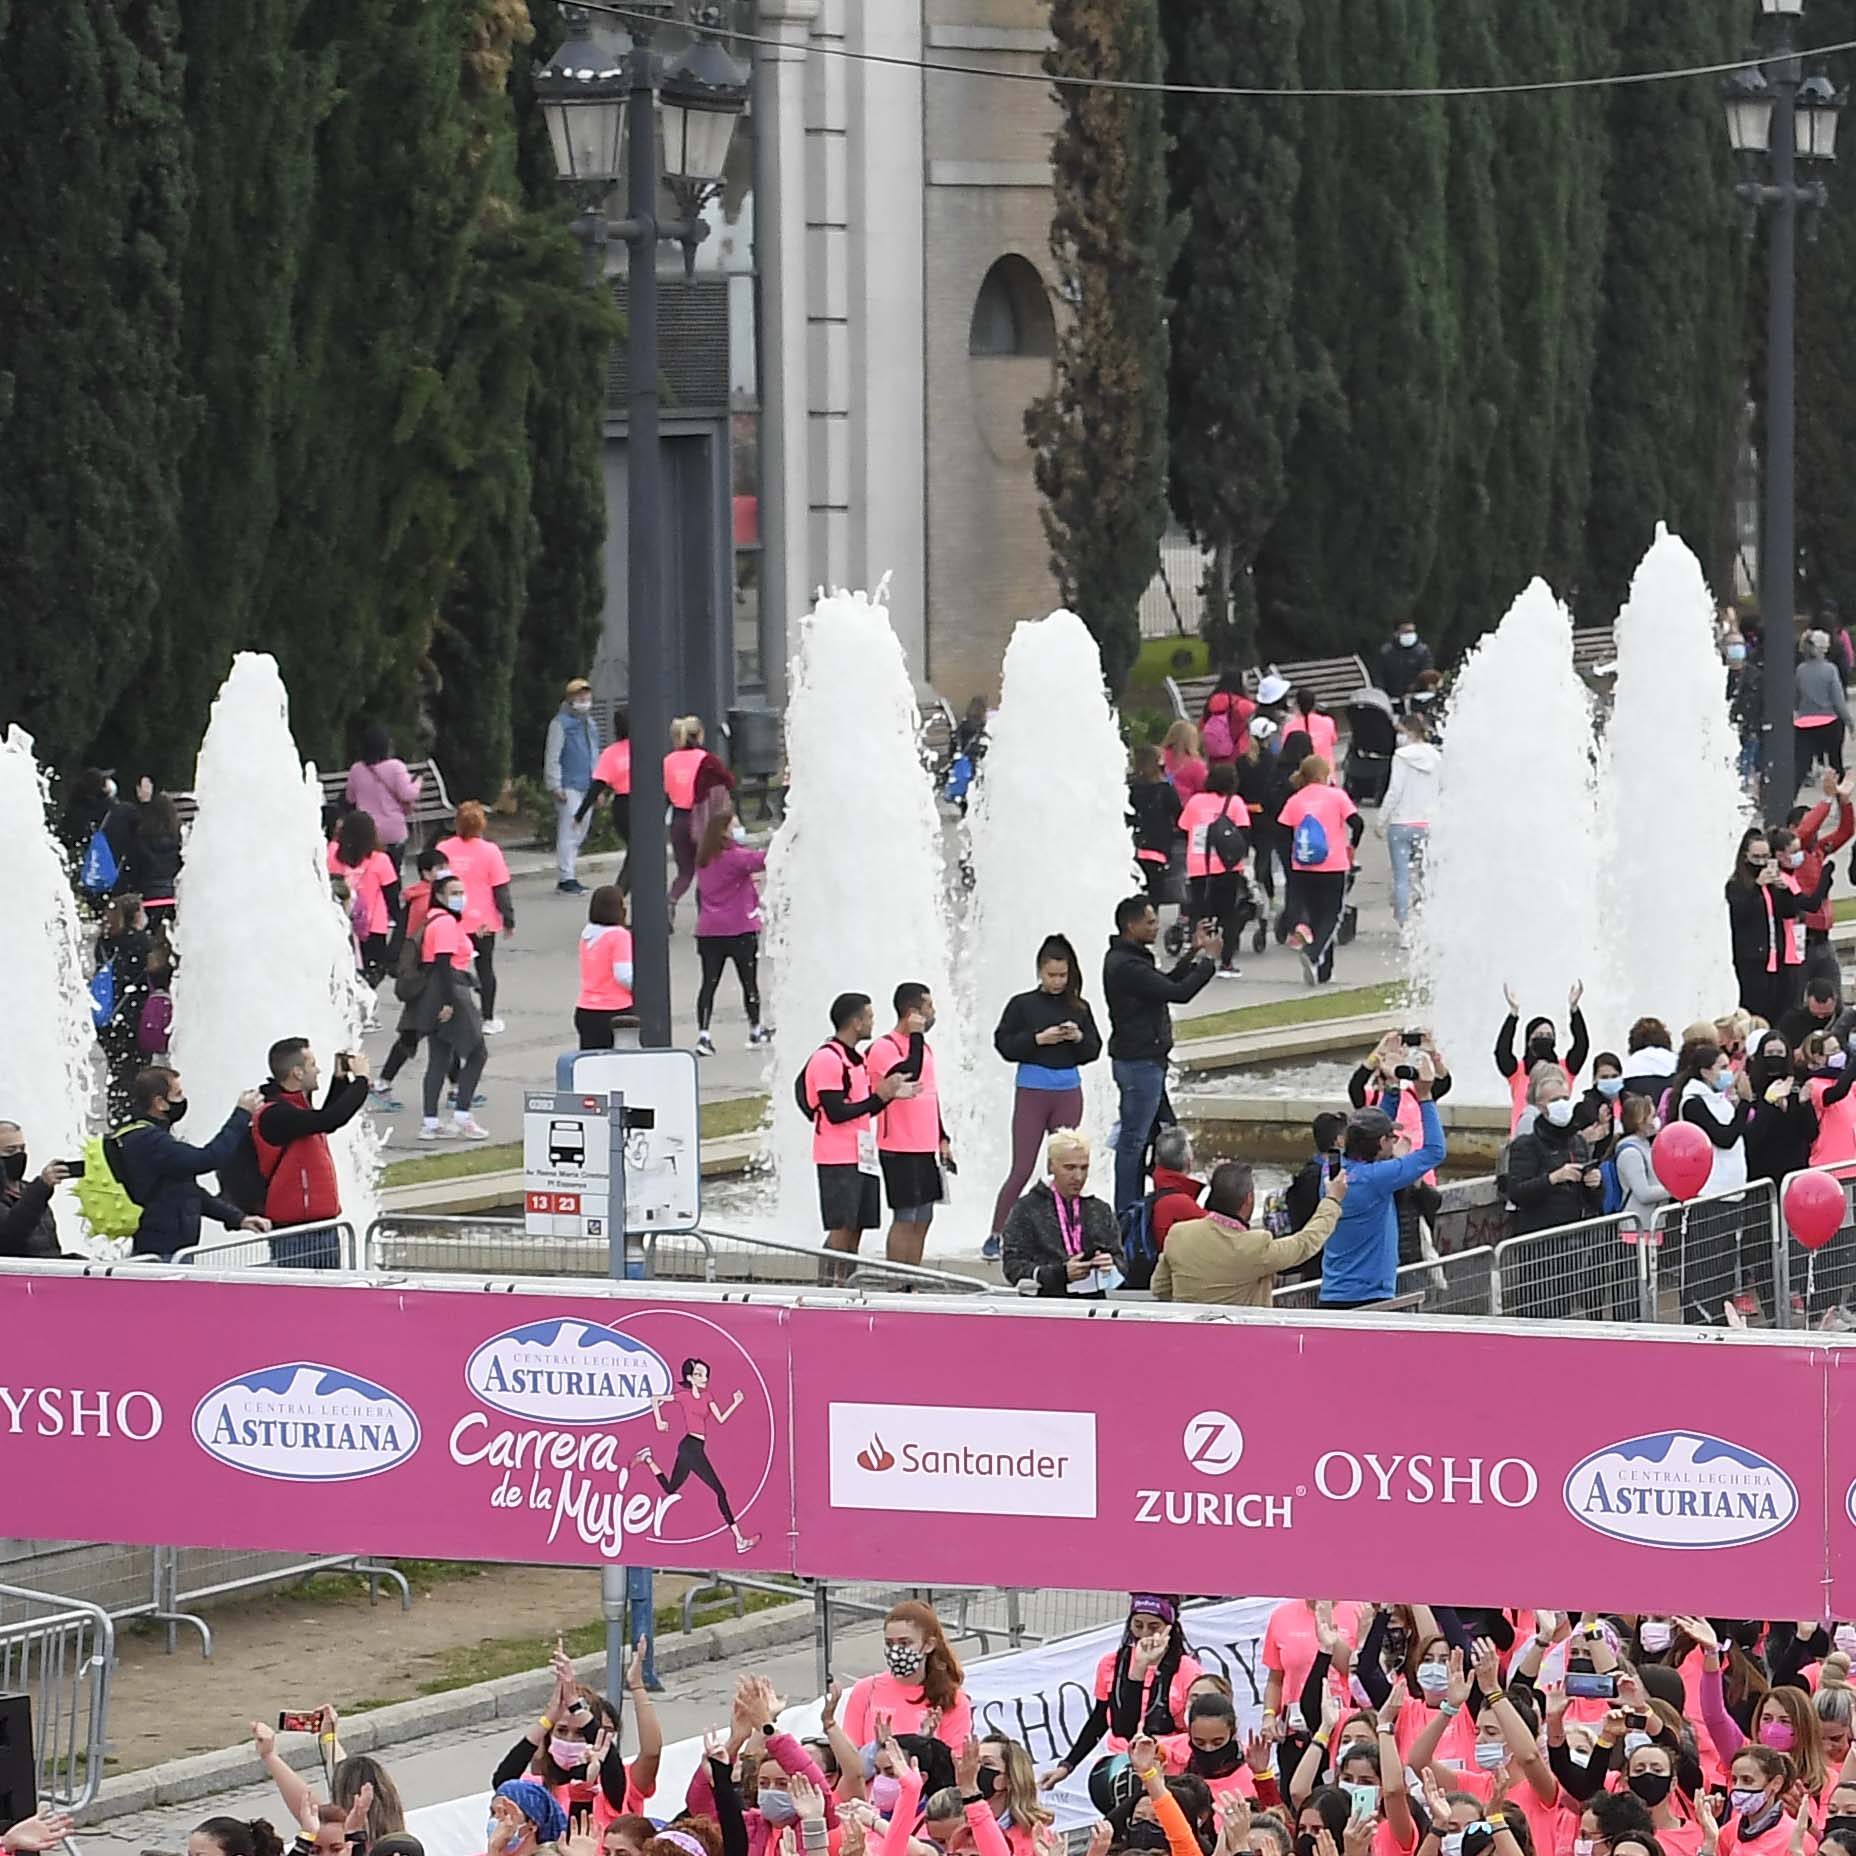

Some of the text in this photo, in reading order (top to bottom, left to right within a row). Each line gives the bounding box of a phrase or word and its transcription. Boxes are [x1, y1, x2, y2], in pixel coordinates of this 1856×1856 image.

[531, 1195, 548, 1210] 13
[558, 1196, 576, 1212] 23
[481, 1353, 654, 1400] ASTURIANA
[512, 1351, 651, 1370] CENTRAL LECHERA
[0, 1389, 163, 1441] YSHO
[210, 1405, 402, 1454] ASTURIANA
[243, 1400, 396, 1421] CENTRAL LECHERA
[449, 1411, 619, 1472] Carrera
[901, 1443, 1069, 1479] Santander
[1314, 1450, 1538, 1508] OYSHO
[1583, 1472, 1780, 1521] ASTURIANA
[1617, 1470, 1773, 1487] CENTRAL LECHERA
[490, 1467, 683, 1558] de la Mujer
[1134, 1490, 1293, 1529] ZURICH
